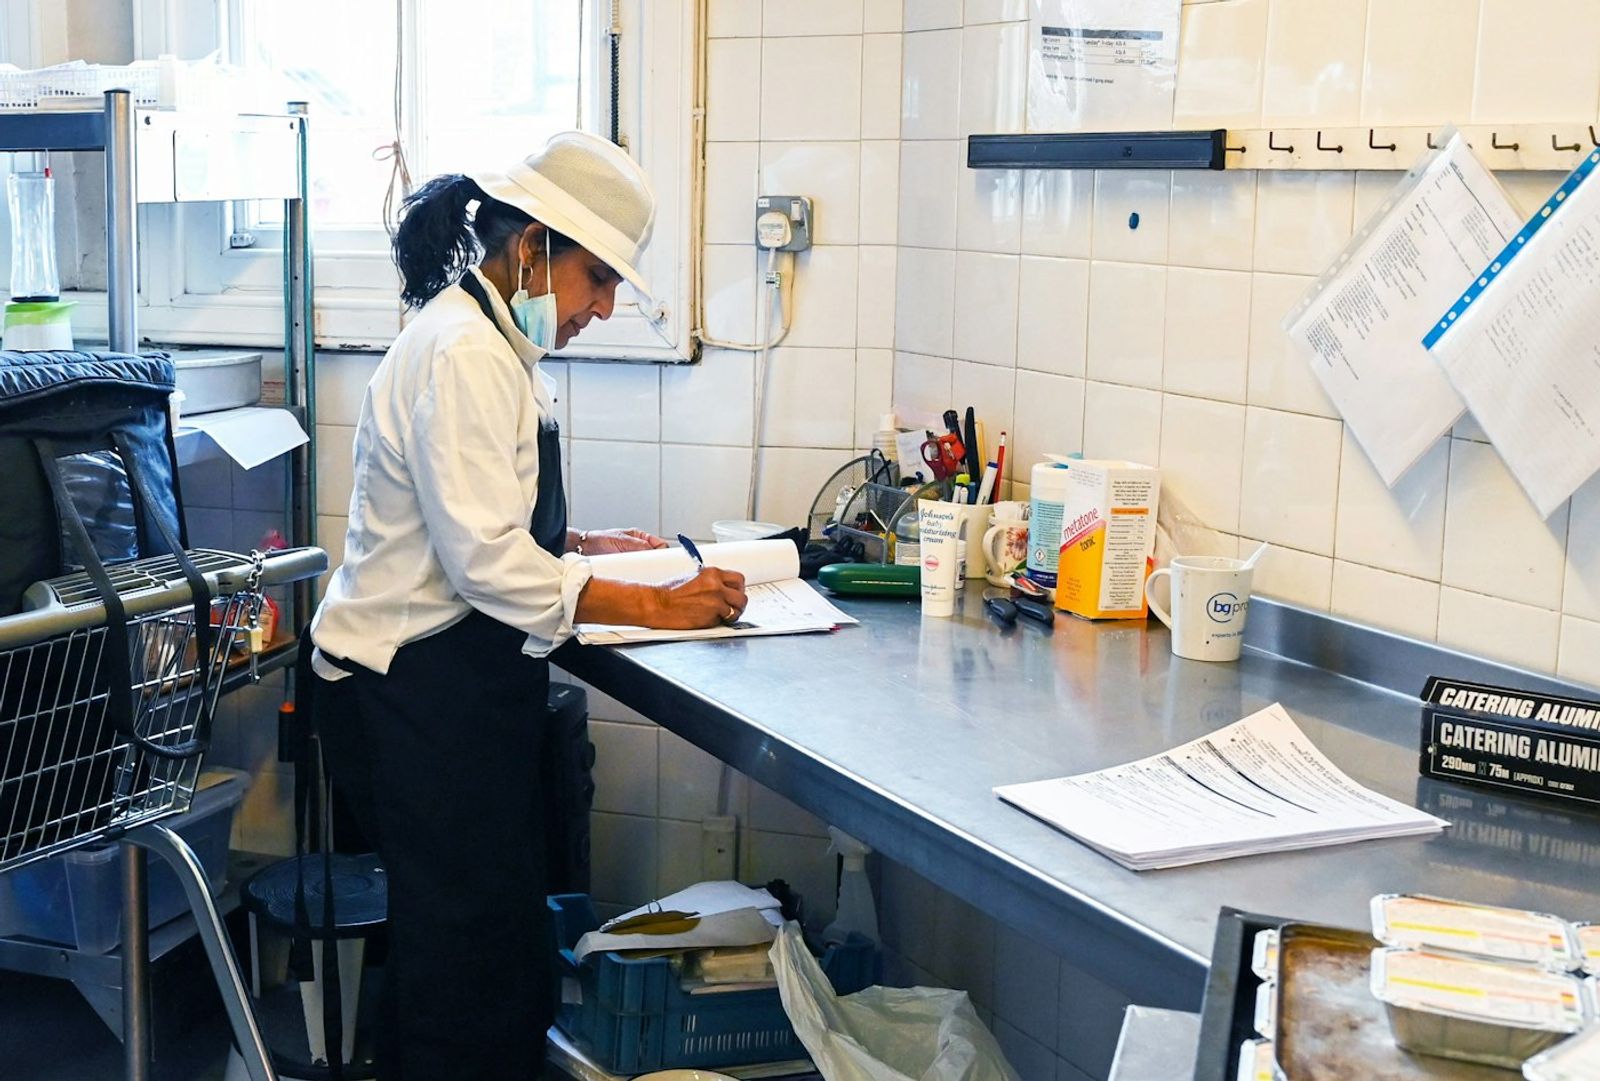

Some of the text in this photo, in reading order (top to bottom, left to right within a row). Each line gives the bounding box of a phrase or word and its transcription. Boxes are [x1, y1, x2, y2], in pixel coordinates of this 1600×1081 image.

[1063, 507, 1098, 541] metatone
[1080, 536, 1096, 552] tonic
[1439, 687, 1600, 732] CATERING ALUMI
[1440, 722, 1531, 760] CATERING
